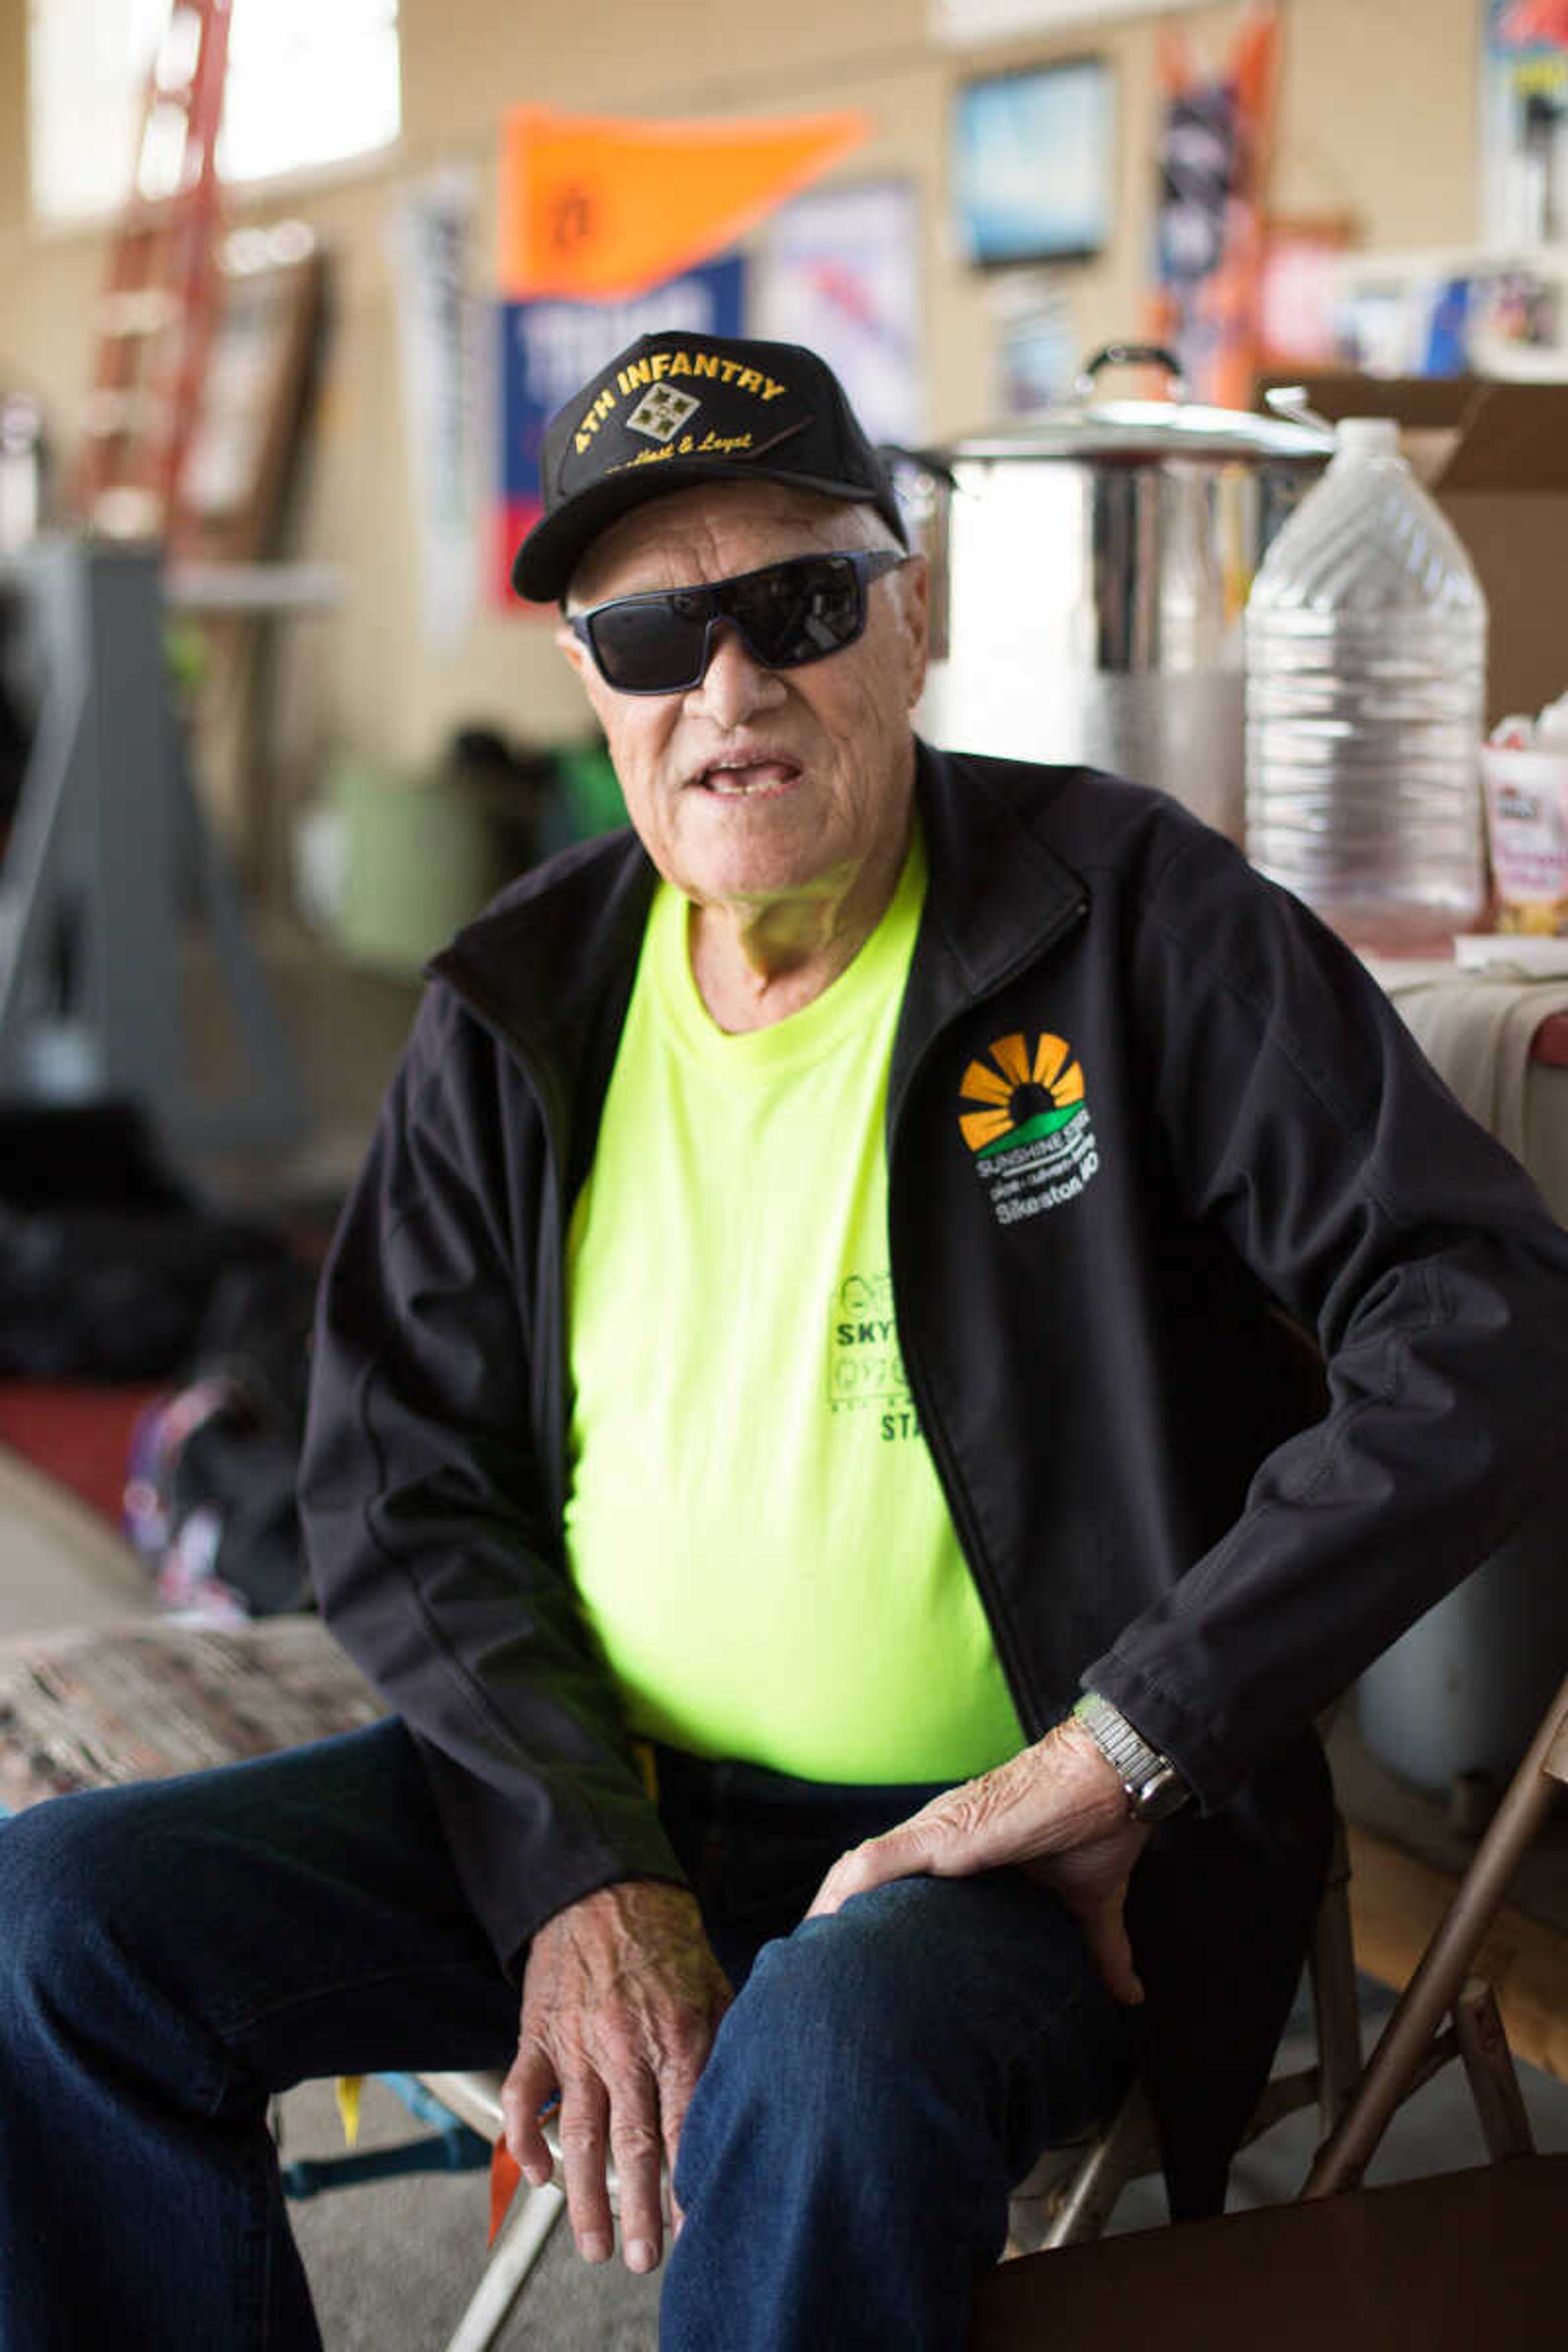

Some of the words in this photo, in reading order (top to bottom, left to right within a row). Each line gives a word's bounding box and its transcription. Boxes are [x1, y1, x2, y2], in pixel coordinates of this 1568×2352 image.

[575, 389, 616, 454] 4TH
[617, 351, 786, 402] INFANTRY
[677, 434, 693, 454] &
[697, 431, 753, 454] Loyal
